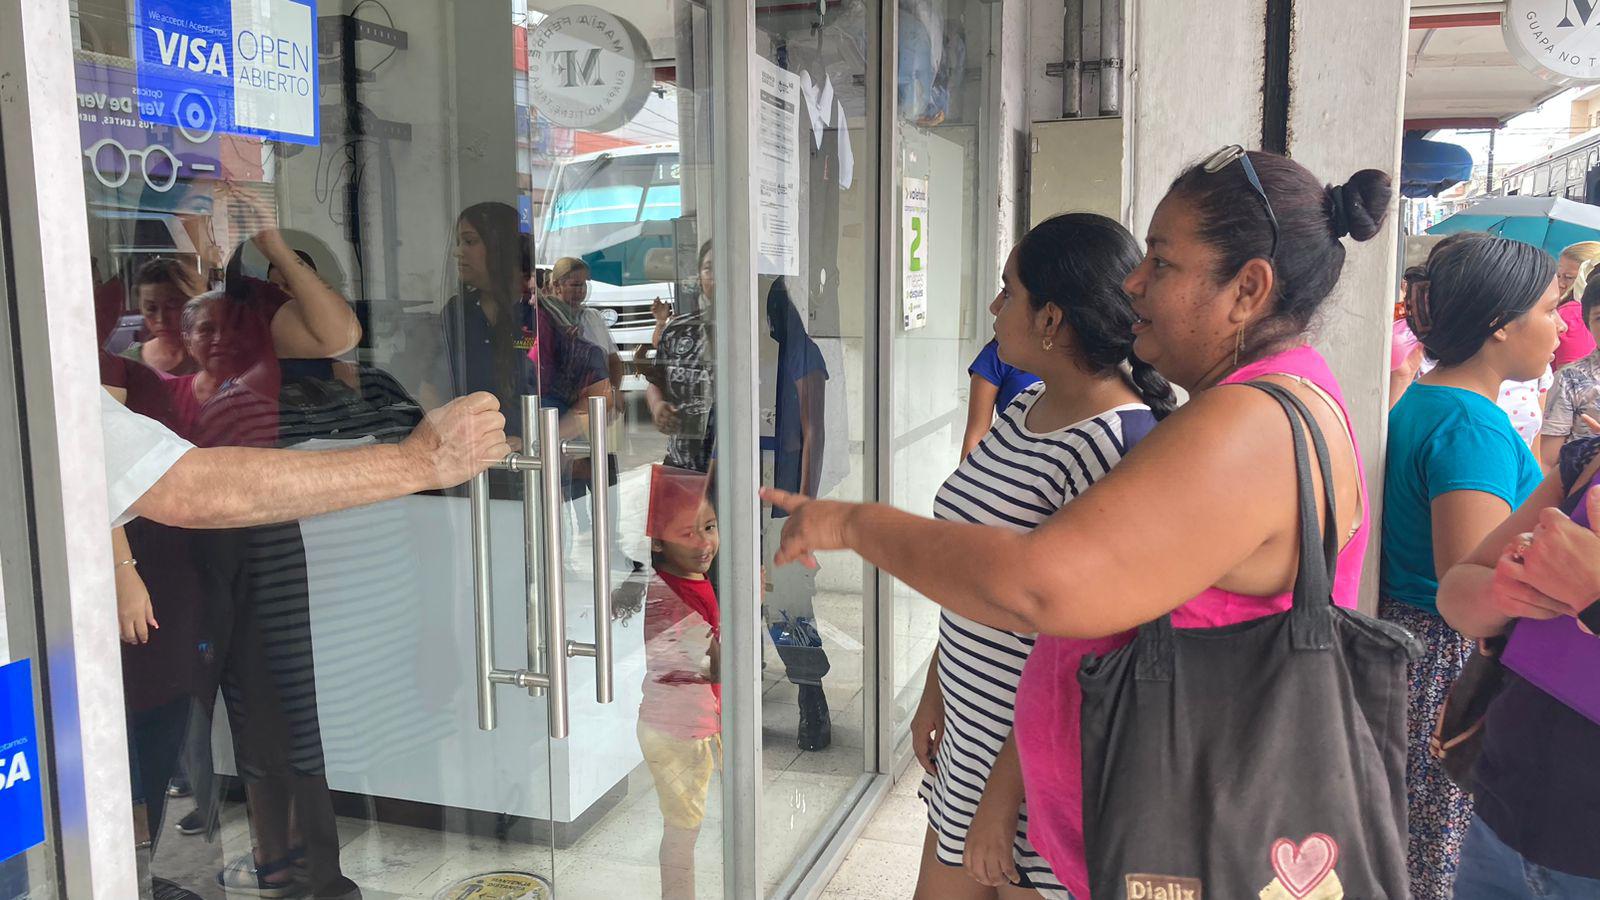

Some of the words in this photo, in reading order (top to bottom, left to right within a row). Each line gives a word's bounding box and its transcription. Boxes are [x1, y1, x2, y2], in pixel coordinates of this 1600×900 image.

[148, 8, 161, 20] We
[161, 15, 185, 28] accept
[189, 21, 228, 38] Aceptamos
[1526, 11, 1554, 54] GUAPA
[1558, 51, 1581, 66] NO
[148, 26, 228, 78] VISA
[237, 30, 310, 74] OPEN
[239, 67, 311, 97] ABIERTO
[909, 216, 922, 272] 2
[1131, 880, 1195, 900] Dialix
